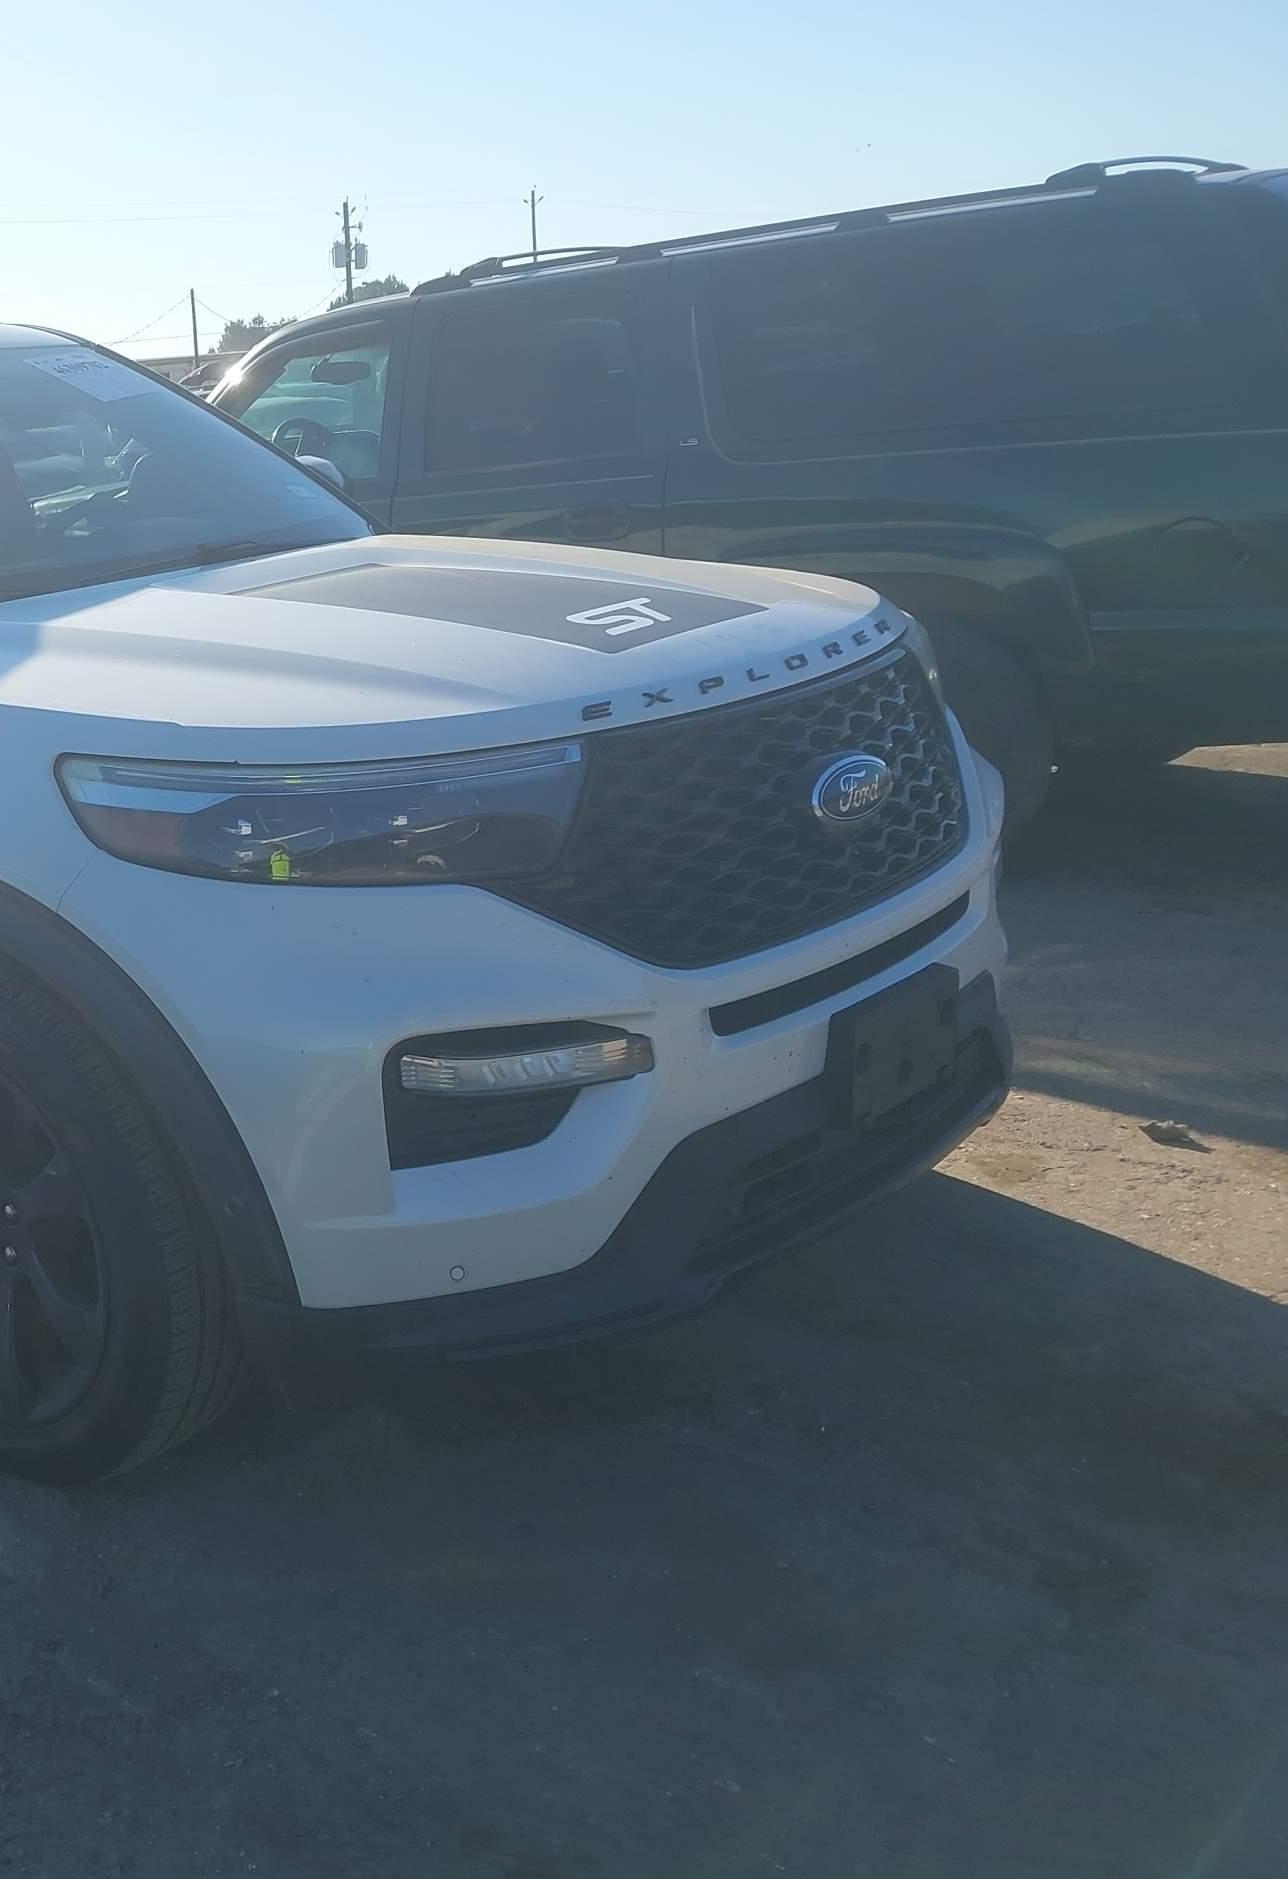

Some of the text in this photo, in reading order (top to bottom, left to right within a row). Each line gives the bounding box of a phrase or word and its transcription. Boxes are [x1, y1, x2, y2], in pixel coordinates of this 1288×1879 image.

[565, 597, 672, 636] ST
[582, 618, 892, 722] EXPLORER
[838, 769, 882, 812] Ford
